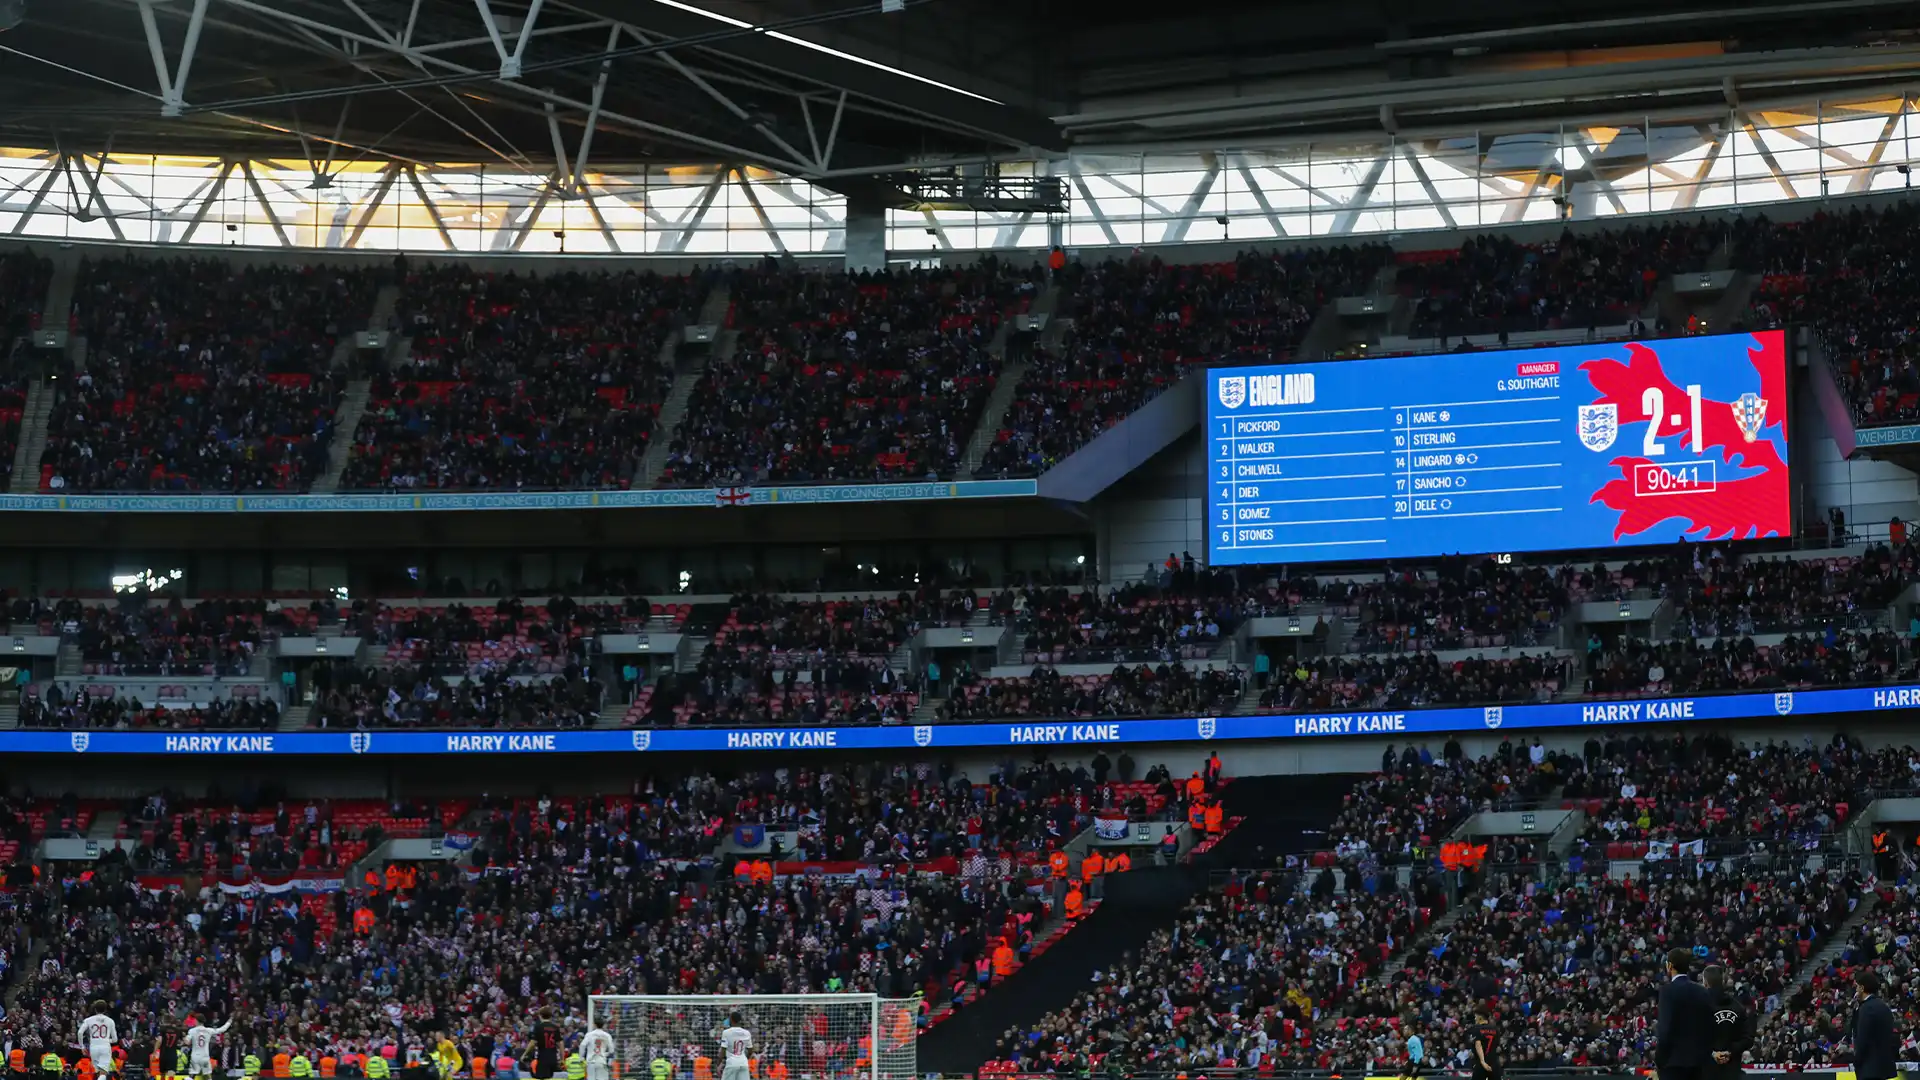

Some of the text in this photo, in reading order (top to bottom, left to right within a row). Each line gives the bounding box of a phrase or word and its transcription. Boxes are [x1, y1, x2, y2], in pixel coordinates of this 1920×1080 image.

[1521, 363, 1556, 374] MANAGER
[1249, 373, 1315, 407] ENGLAND
[1498, 376, 1560, 392] G. SOUTHGATE
[1396, 412, 1437, 424] 9 KANE
[1222, 420, 1280, 434] 1 PICKFORD
[1394, 432, 1456, 446] 10 STERLING
[1858, 429, 1917, 444] WEMBLEY
[1222, 442, 1275, 456] 2 WALKER
[1396, 454, 1452, 468] 14 LINGARD
[1222, 464, 1282, 476] 3 CHILWELL
[1396, 477, 1452, 490] 17 SANCHO
[1647, 467, 1699, 490] 90:41
[603, 494, 658, 505] WEMBLEY
[662, 493, 712, 504] CONNEC
[754, 490, 767, 500] EE
[782, 484, 947, 500] WEMBLEY CONNECTED BY EE
[1222, 486, 1259, 499] 4 DIER
[24, 498, 39, 508] BY
[42, 499, 57, 508] EE
[70, 499, 232, 509] WEMBLEY CONNECTED BY EE
[247, 498, 411, 508] WEMBLEY CONNECTED BY EE
[425, 495, 588, 506] WEMBLEY CONNECTED BY EE
[1395, 500, 1437, 512] 20 DELE
[1222, 508, 1271, 520] 5 GOMEZ
[1222, 529, 1274, 542] 6 STONES
[1498, 554, 1512, 564] LG
[1582, 702, 1694, 722] HARRY KANE
[1294, 714, 1405, 734] HARRY KANE
[728, 731, 836, 748] HARRY KANE
[1010, 724, 1120, 742] HARRY KANE
[166, 736, 273, 751] HARRY KANE
[448, 735, 556, 751] HARRY KANE
[91, 1024, 108, 1038] 20
[166, 1033, 176, 1048] 17
[198, 1035, 206, 1048] 6
[1485, 1034, 1494, 1054] 7
[734, 1040, 744, 1056] 10
